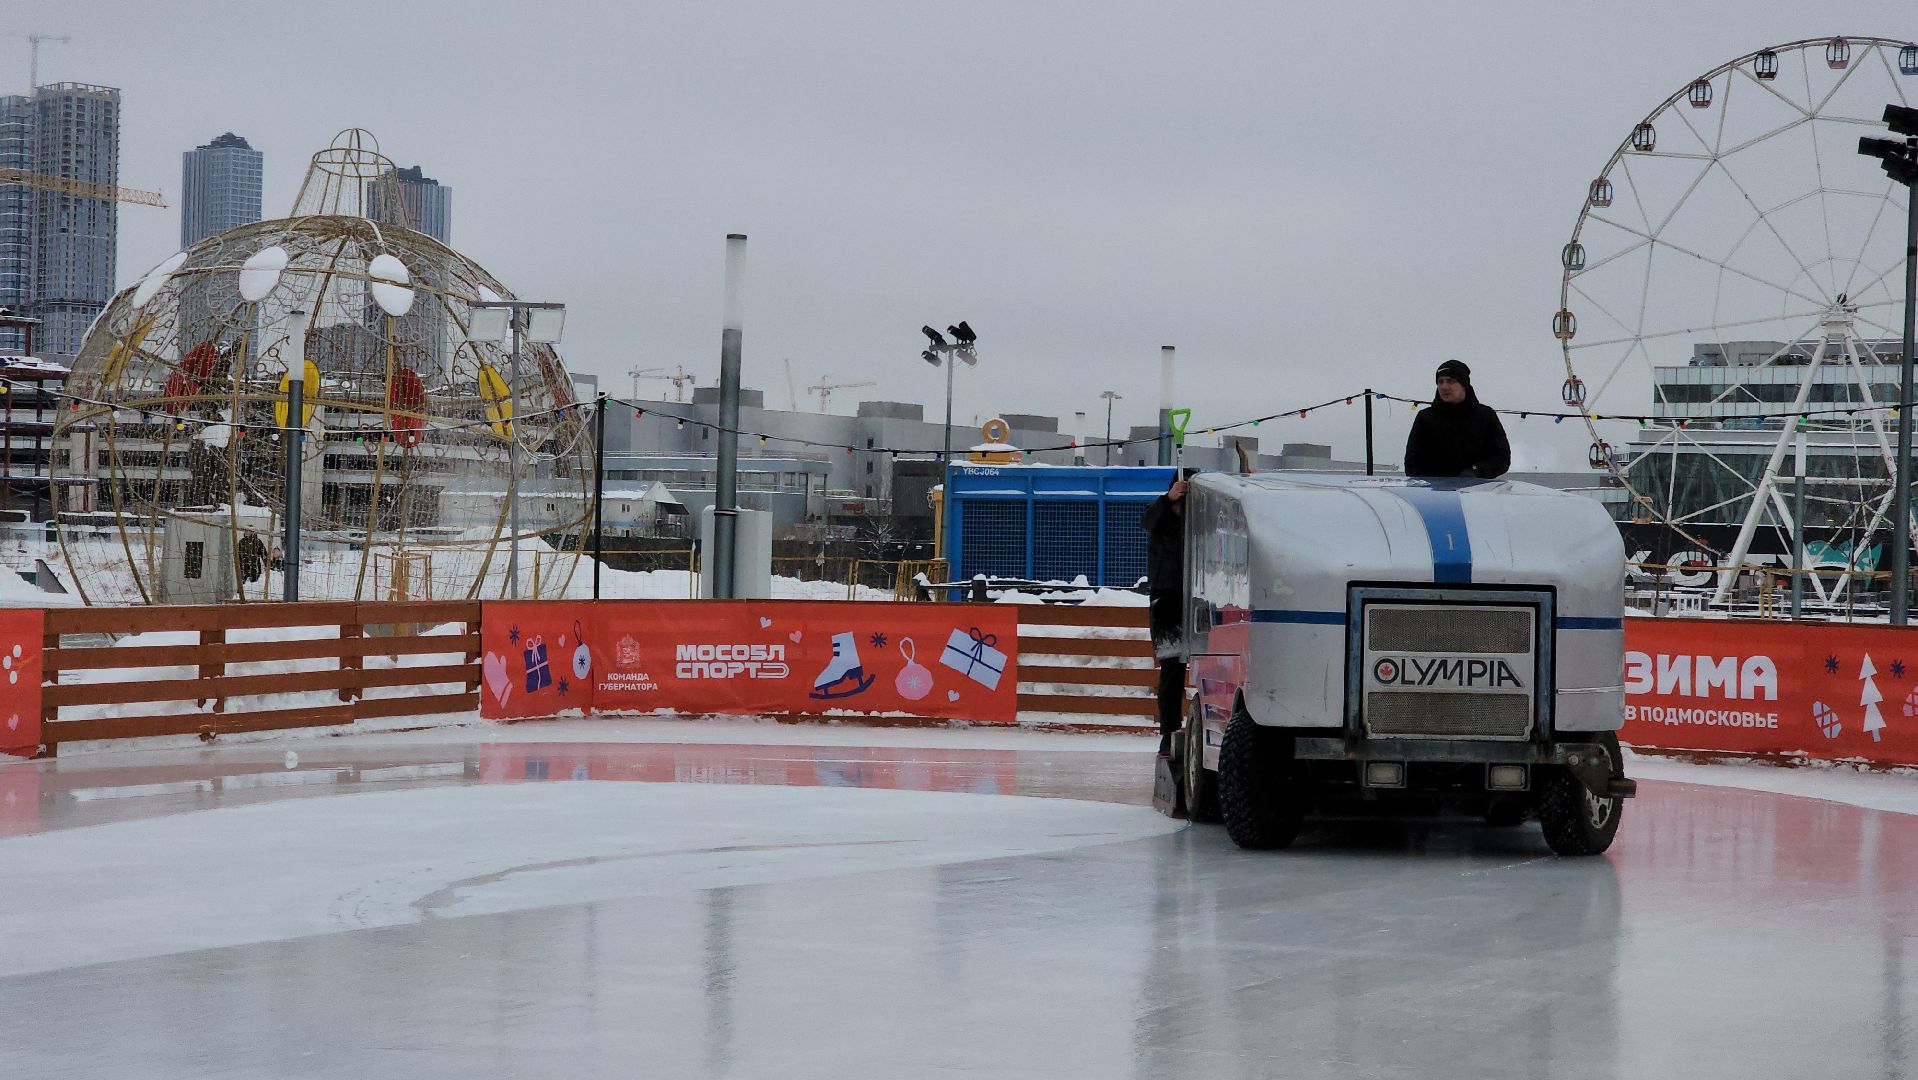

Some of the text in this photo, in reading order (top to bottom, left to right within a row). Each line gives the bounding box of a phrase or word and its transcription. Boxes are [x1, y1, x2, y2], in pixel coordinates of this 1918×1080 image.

[676, 644, 785, 661] МОСОБЛ
[607, 673, 650, 681] КОМАНДА
[676, 662, 762, 679] СПОРТ
[1373, 658, 1522, 687] OLYMPIA
[1625, 651, 1778, 701] ЗИМА
[598, 683, 658, 691] ГУБЕРНАТОРА
[1625, 705, 1779, 729] В ПОДМОСКОВЬЕ
